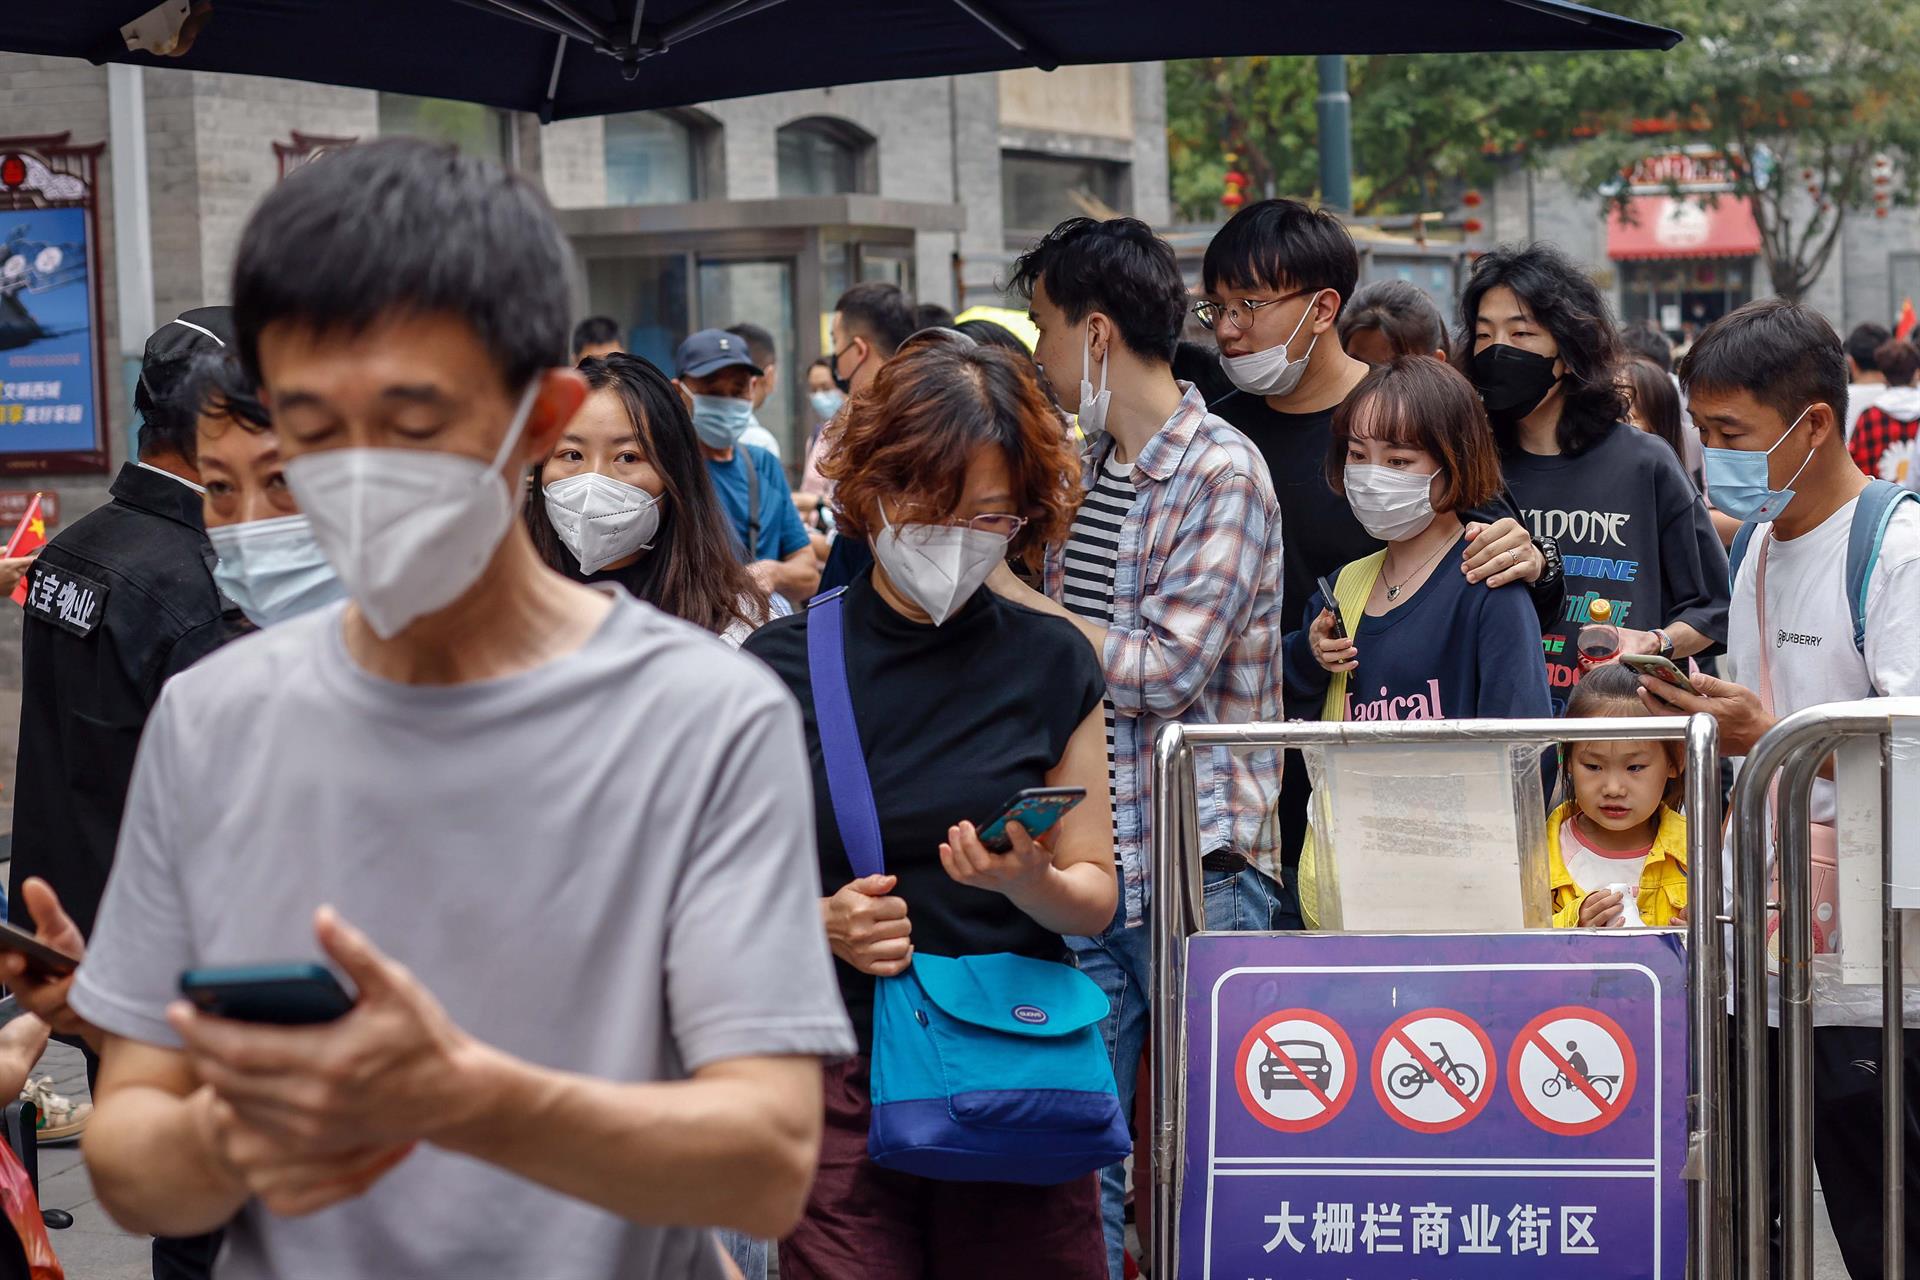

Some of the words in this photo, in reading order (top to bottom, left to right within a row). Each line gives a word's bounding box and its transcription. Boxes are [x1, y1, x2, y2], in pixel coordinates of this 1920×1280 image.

[1262, 1200, 1600, 1257] 大栅栏商业街区
